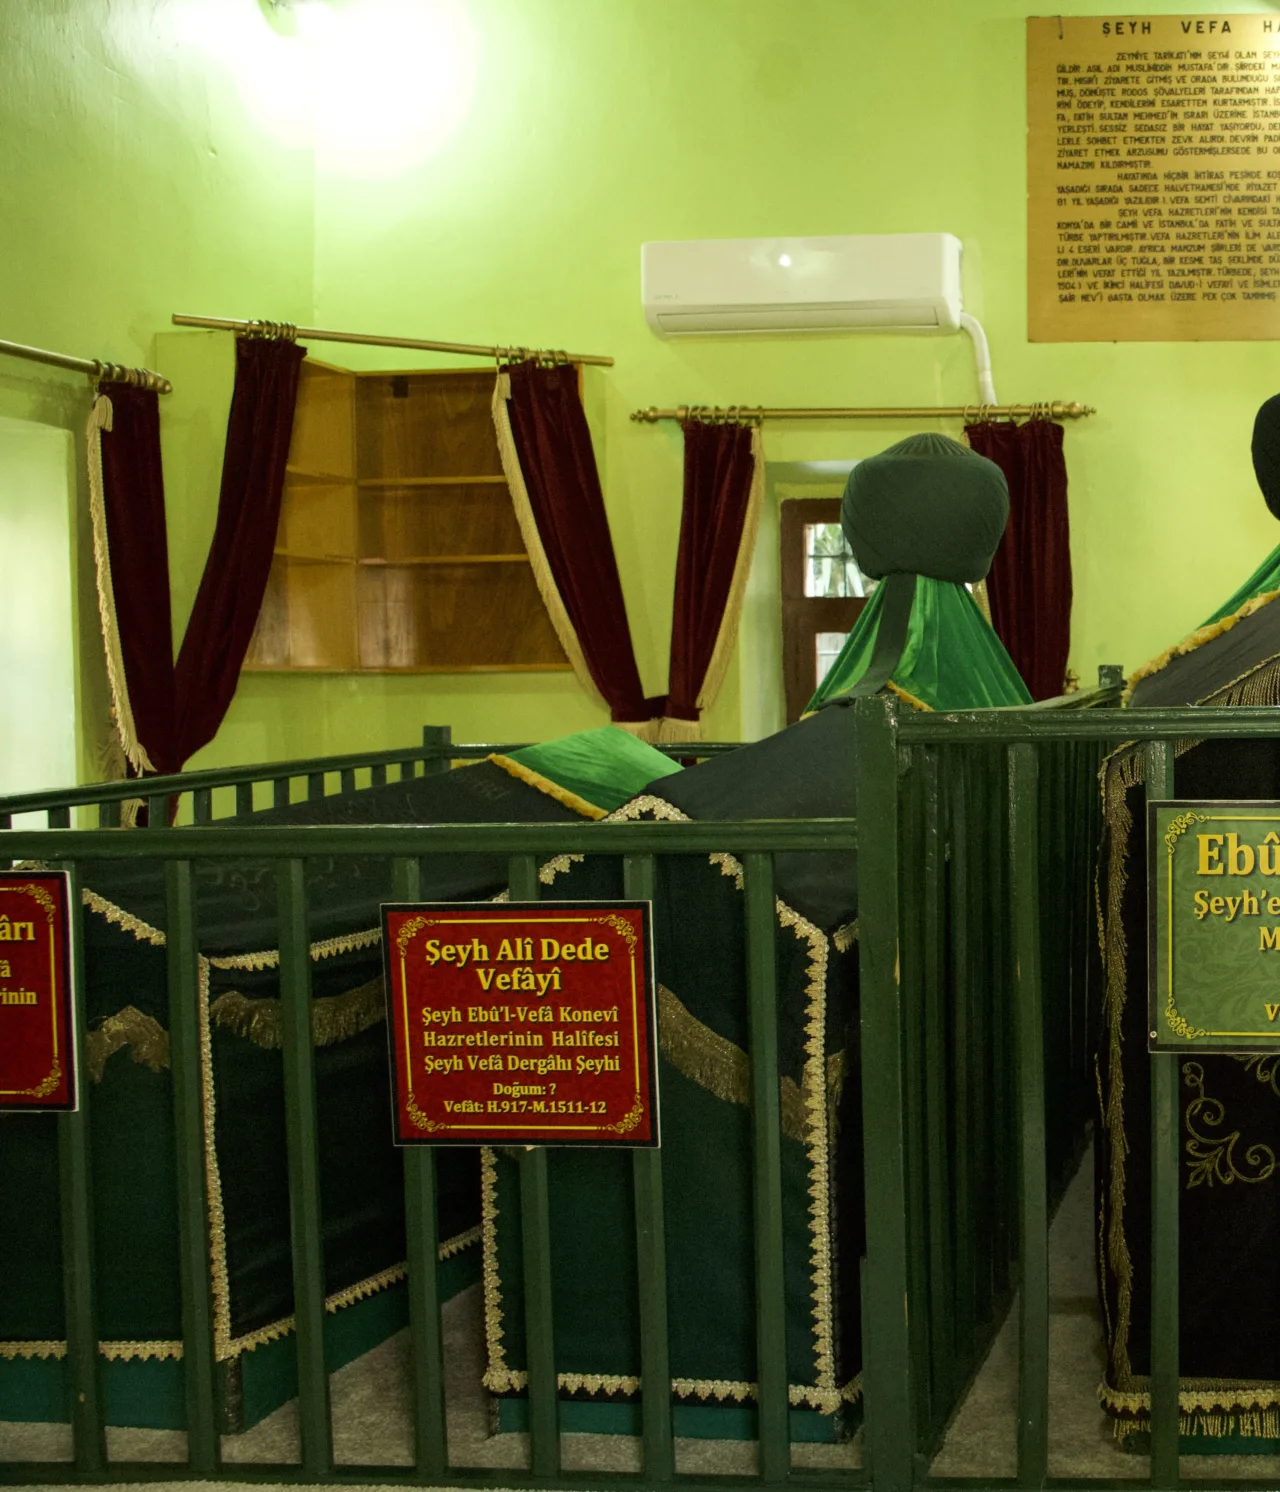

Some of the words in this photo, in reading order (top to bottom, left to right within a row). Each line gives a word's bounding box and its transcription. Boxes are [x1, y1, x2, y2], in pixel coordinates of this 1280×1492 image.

[1101, 20, 1152, 37] ŞEYH
[1180, 19, 1232, 34] VEFA
[1175, 75, 1188, 84] VE
[1190, 75, 1218, 84] ORADA
[1121, 87, 1149, 97] RODOS
[1172, 121, 1186, 132] BİR
[1190, 122, 1214, 132] HAYAT
[1171, 135, 1193, 144] ZEVK
[1094, 147, 1121, 157] ETMEK
[1256, 146, 1268, 155] BU
[1128, 183, 1159, 193] SADECE
[1169, 195, 1190, 205] VEFA
[1142, 207, 1163, 217] VEFA
[1241, 219, 1253, 228] VE
[1149, 231, 1171, 241] VEFA
[1246, 243, 1257, 252] DE
[1086, 280, 1099, 289] VE
[426, 939, 489, 967] Şeyh
[496, 938, 533, 961] Alî
[541, 938, 609, 960] Dede
[477, 967, 561, 995] Vefâyî
[422, 1007, 461, 1026] Şeyh
[468, 1007, 553, 1022] Ebû'l-Vefâ
[559, 1006, 618, 1022] Konevî
[424, 1031, 543, 1047] Hazretlerinin
[552, 1031, 619, 1047] Halîfesi
[425, 1055, 463, 1074] Şeyh
[467, 1055, 504, 1071] Vefâ
[508, 1055, 572, 1074] Dergâhı
[576, 1055, 620, 1074] Şeyhi
[493, 1082, 545, 1097] Doğum:
[549, 1083, 556, 1094] ?
[444, 1101, 484, 1113] Vefât:
[487, 1101, 606, 1113] H.917-M.1511-12
